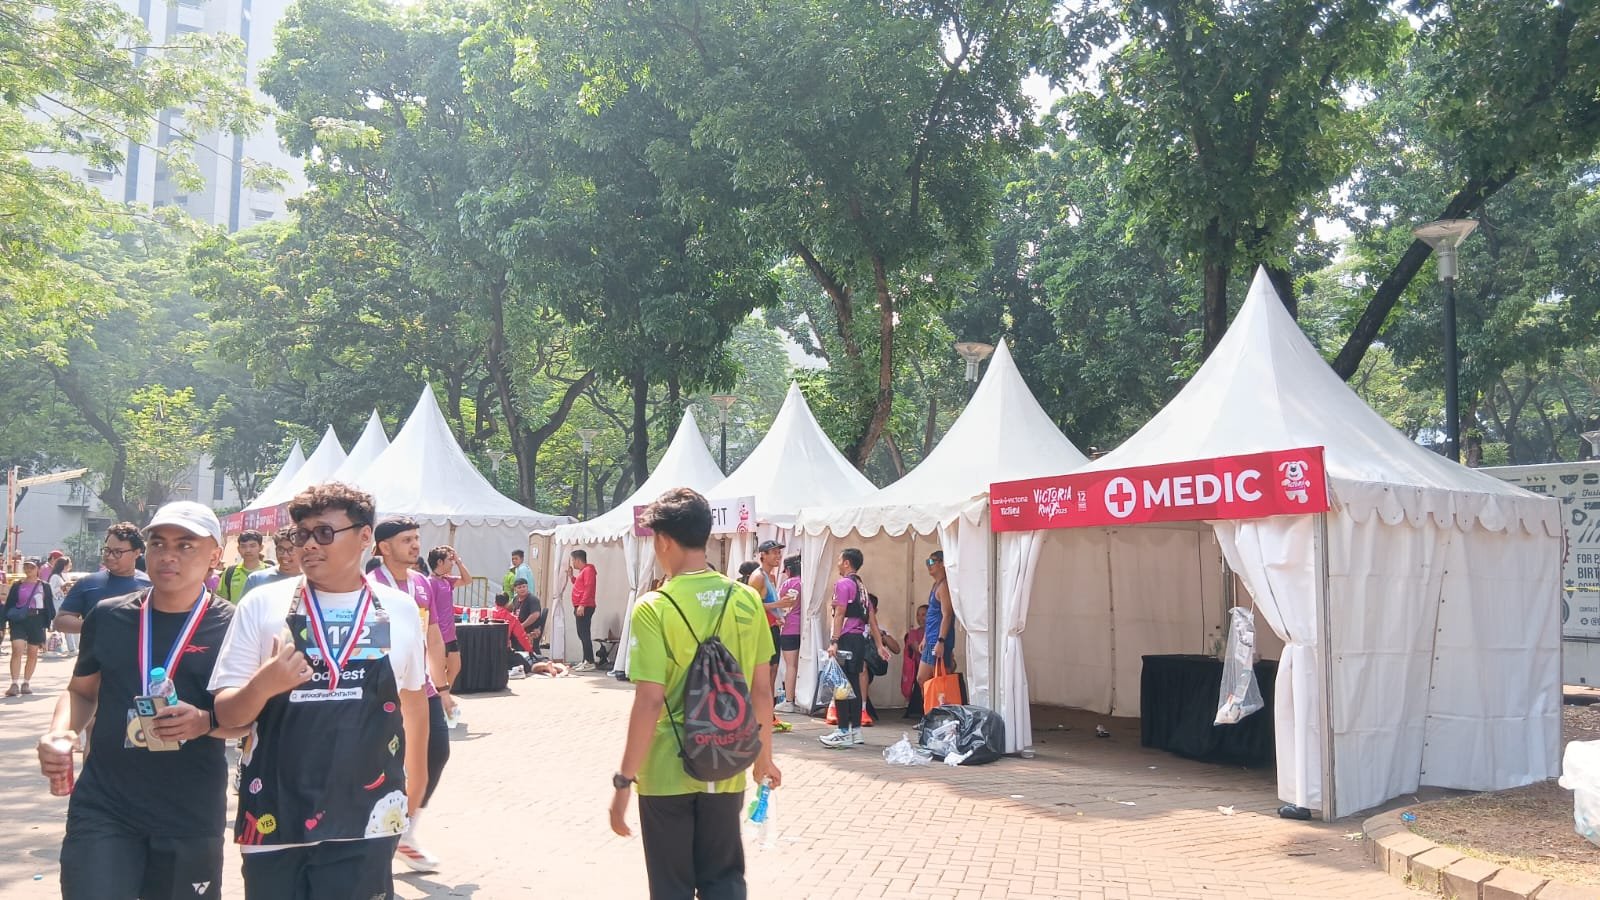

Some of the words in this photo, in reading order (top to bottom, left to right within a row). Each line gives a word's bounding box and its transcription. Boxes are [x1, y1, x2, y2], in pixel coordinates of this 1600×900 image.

[1033, 485, 1072, 504] VICTORIA
[1143, 469, 1263, 509] MEDIC
[1576, 553, 1592, 564] FOR
[261, 819, 274, 829] YES
